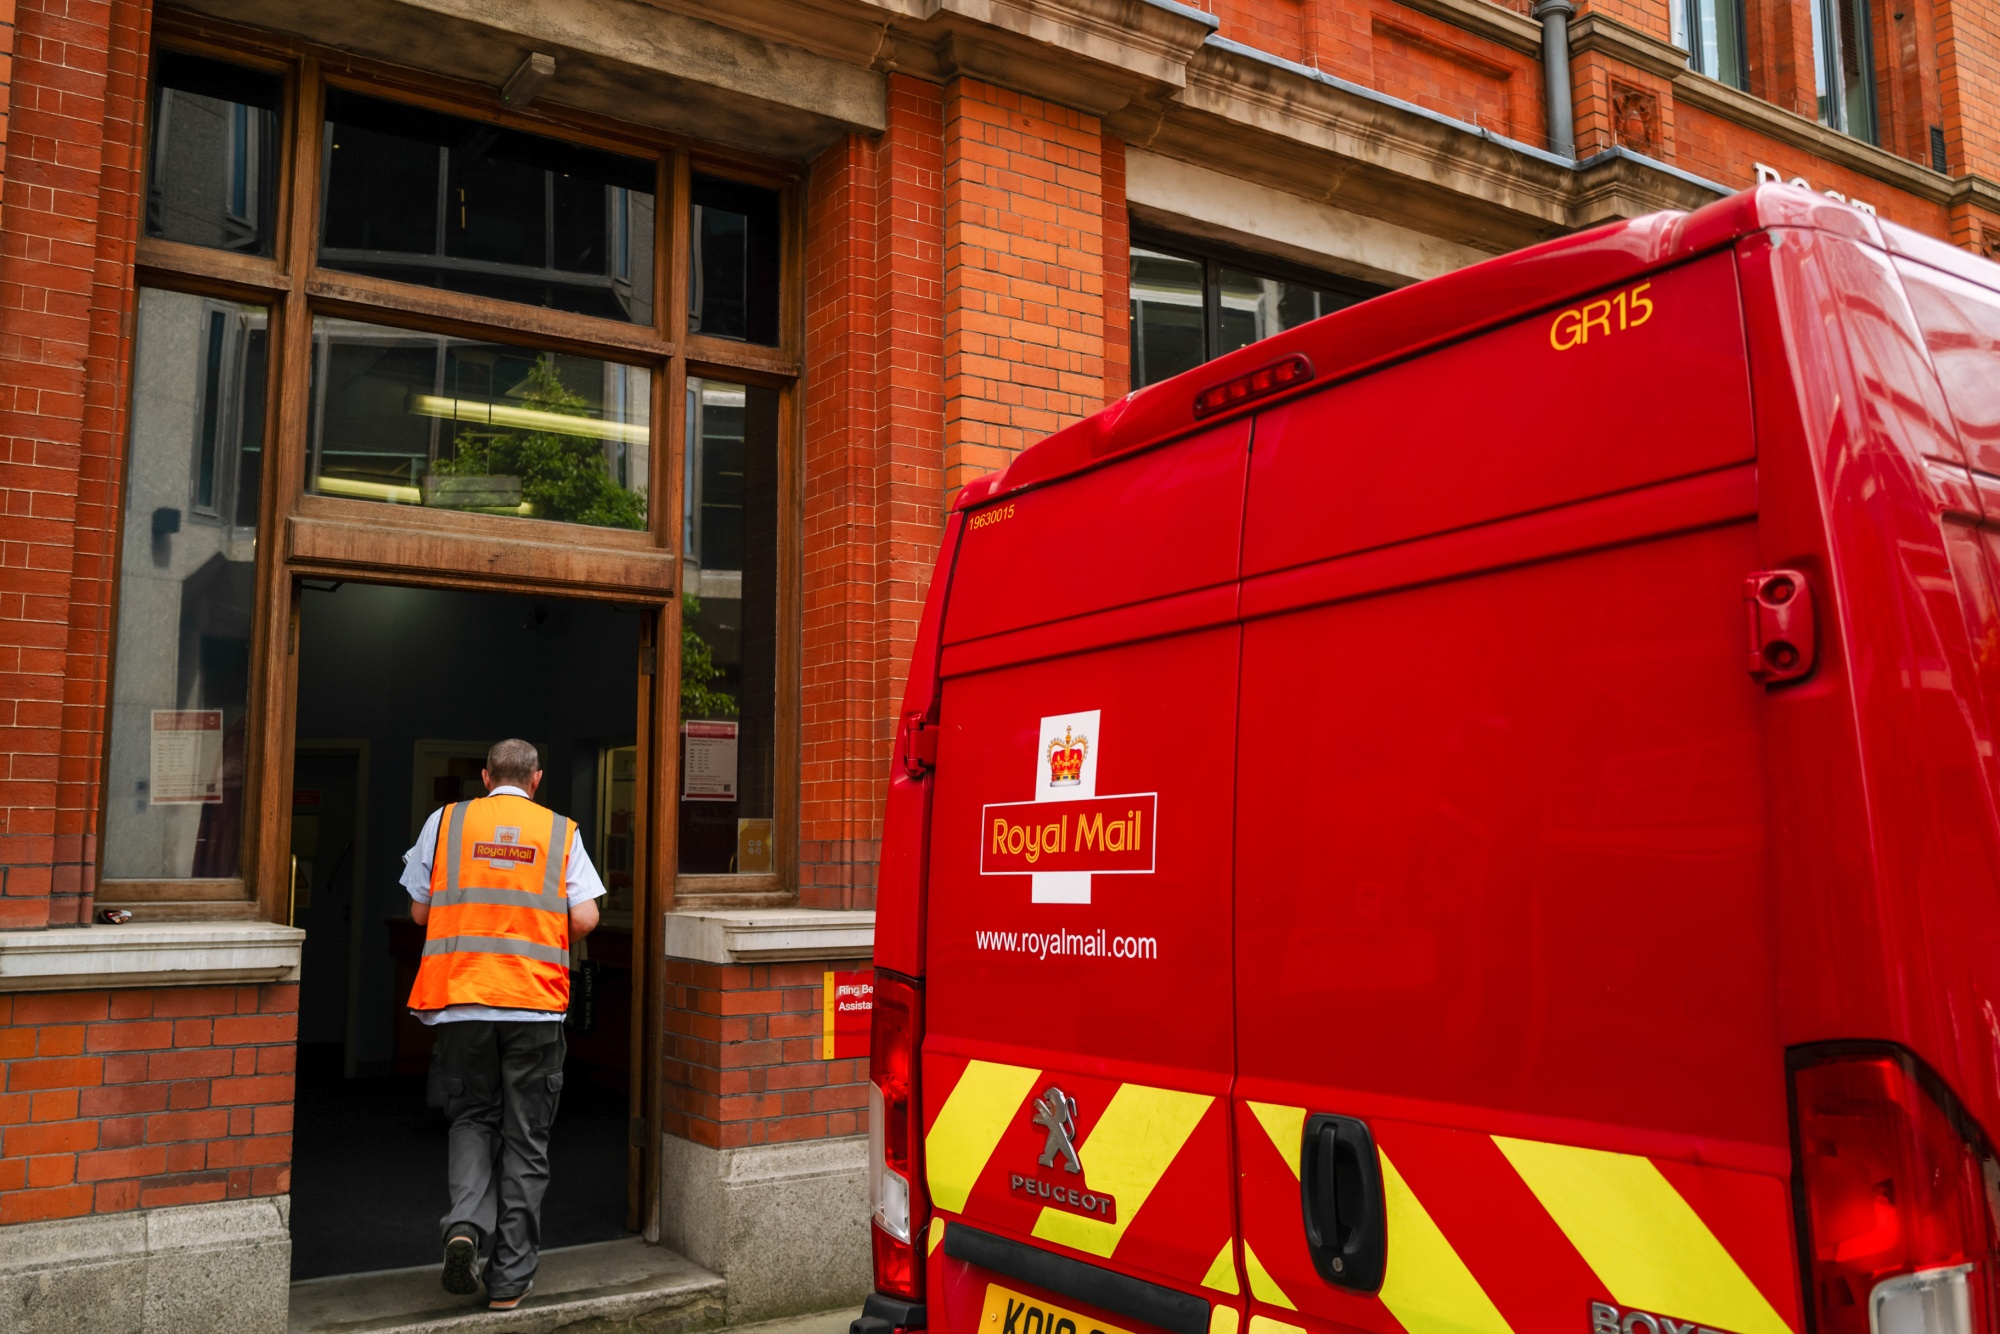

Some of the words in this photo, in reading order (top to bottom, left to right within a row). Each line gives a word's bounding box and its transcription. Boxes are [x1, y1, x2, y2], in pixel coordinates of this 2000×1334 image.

[1550, 282, 1654, 351] GR15
[969, 504, 1015, 531] 19630015
[477, 845, 507, 857] Royal
[508, 848, 532, 859] Mail
[992, 815, 1067, 863] Royal
[1075, 810, 1141, 852] Mail
[976, 928, 1157, 960] www.royalmail.com
[838, 985, 860, 997] Ring
[1011, 1174, 1111, 1215] PEUGEOT
[1591, 1301, 1726, 1334] BO
